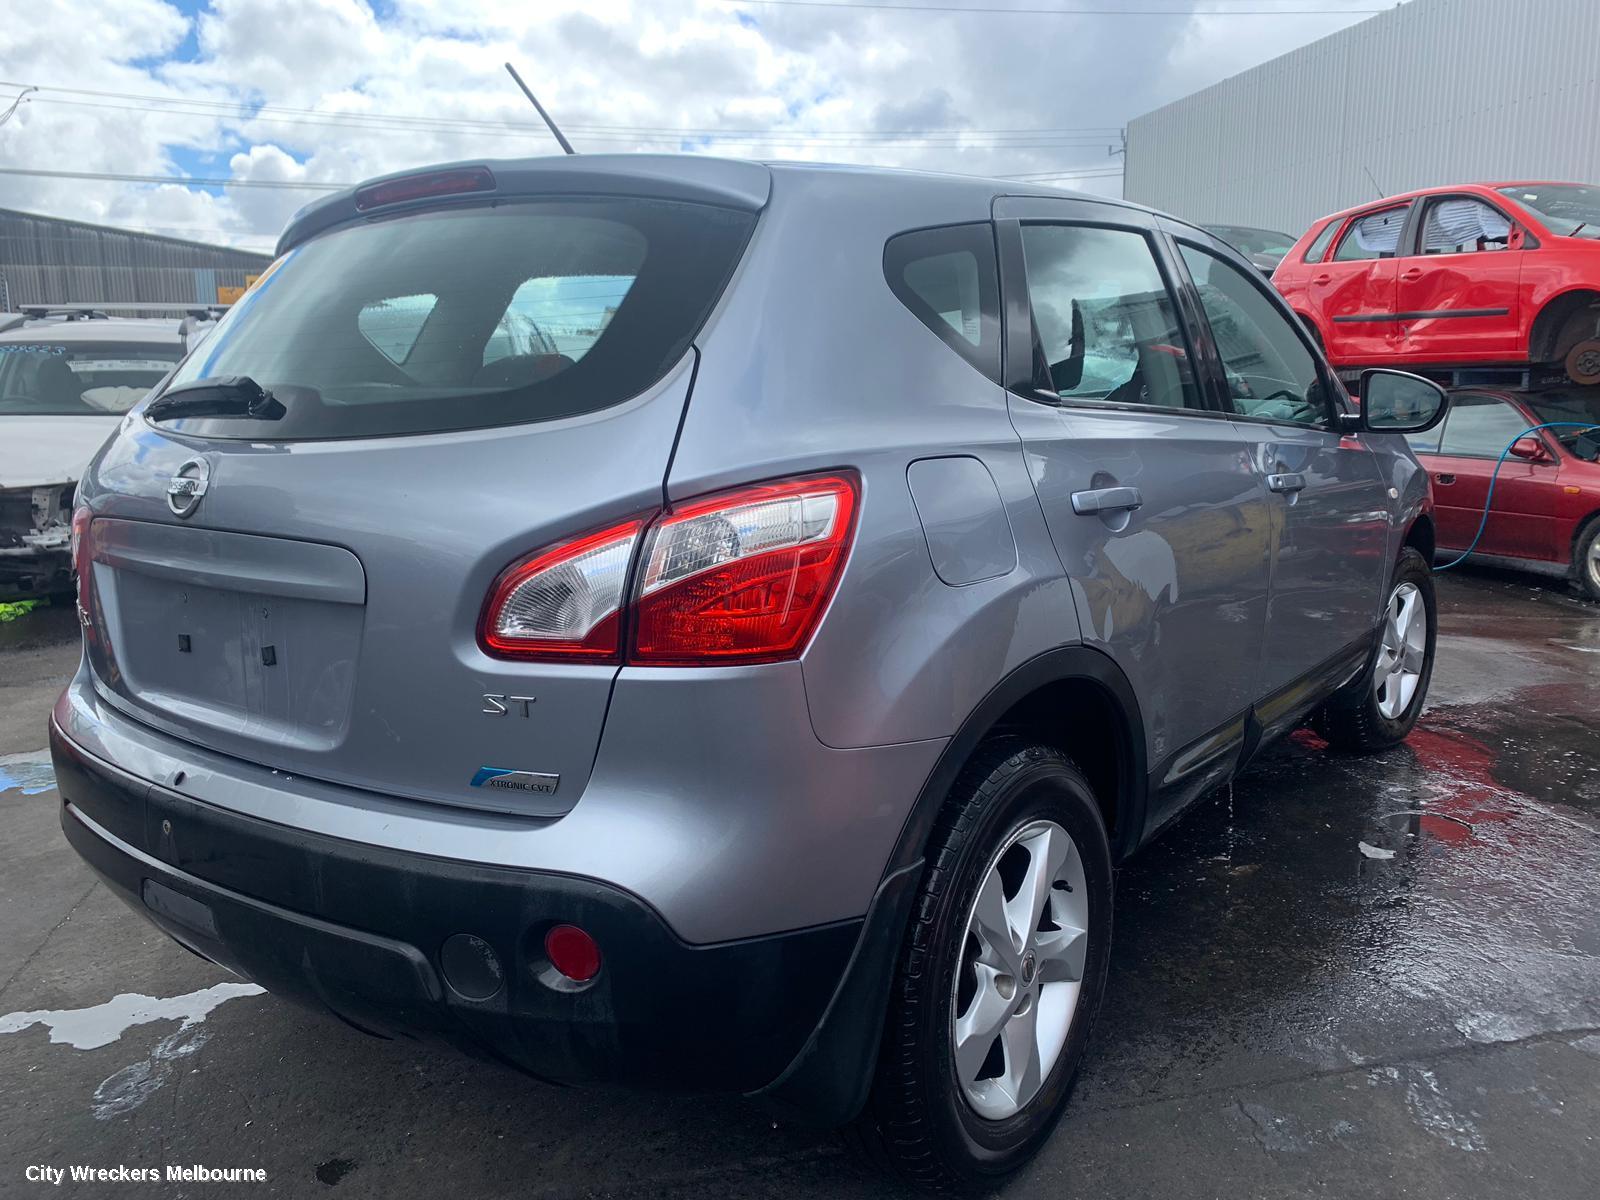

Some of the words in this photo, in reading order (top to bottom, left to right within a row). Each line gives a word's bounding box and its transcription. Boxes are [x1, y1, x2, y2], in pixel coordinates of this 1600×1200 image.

[481, 693, 537, 719] ST
[490, 780, 530, 791] XTRONIC
[531, 783, 552, 793] CVT
